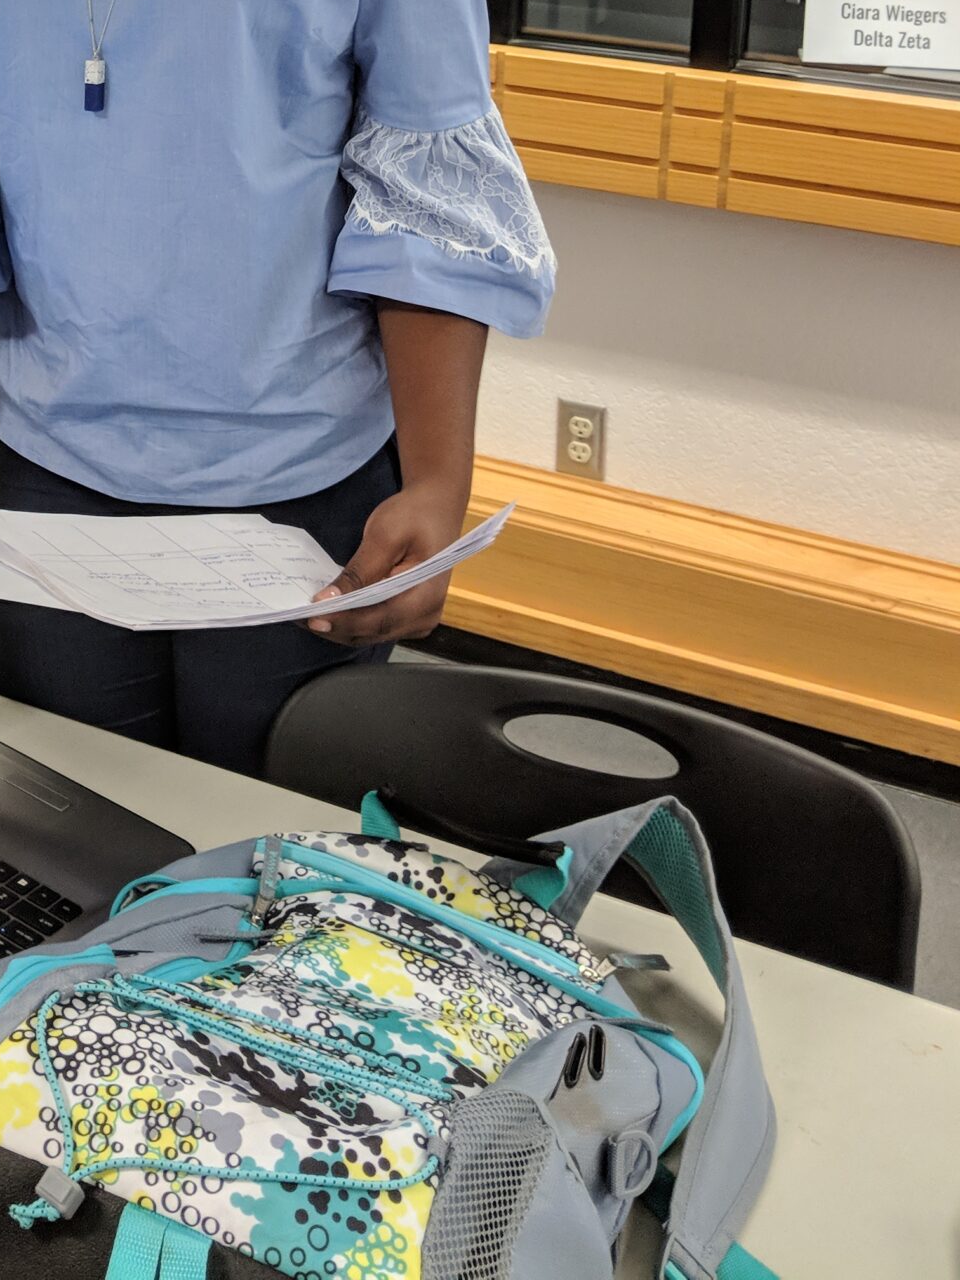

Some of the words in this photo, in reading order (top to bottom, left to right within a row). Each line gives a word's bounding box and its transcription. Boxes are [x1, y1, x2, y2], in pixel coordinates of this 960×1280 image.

[841, 2, 880, 21] Ciara
[886, 4, 947, 26] Wiegers
[853, 29, 893, 48] Delta
[898, 31, 931, 50] Zeta
